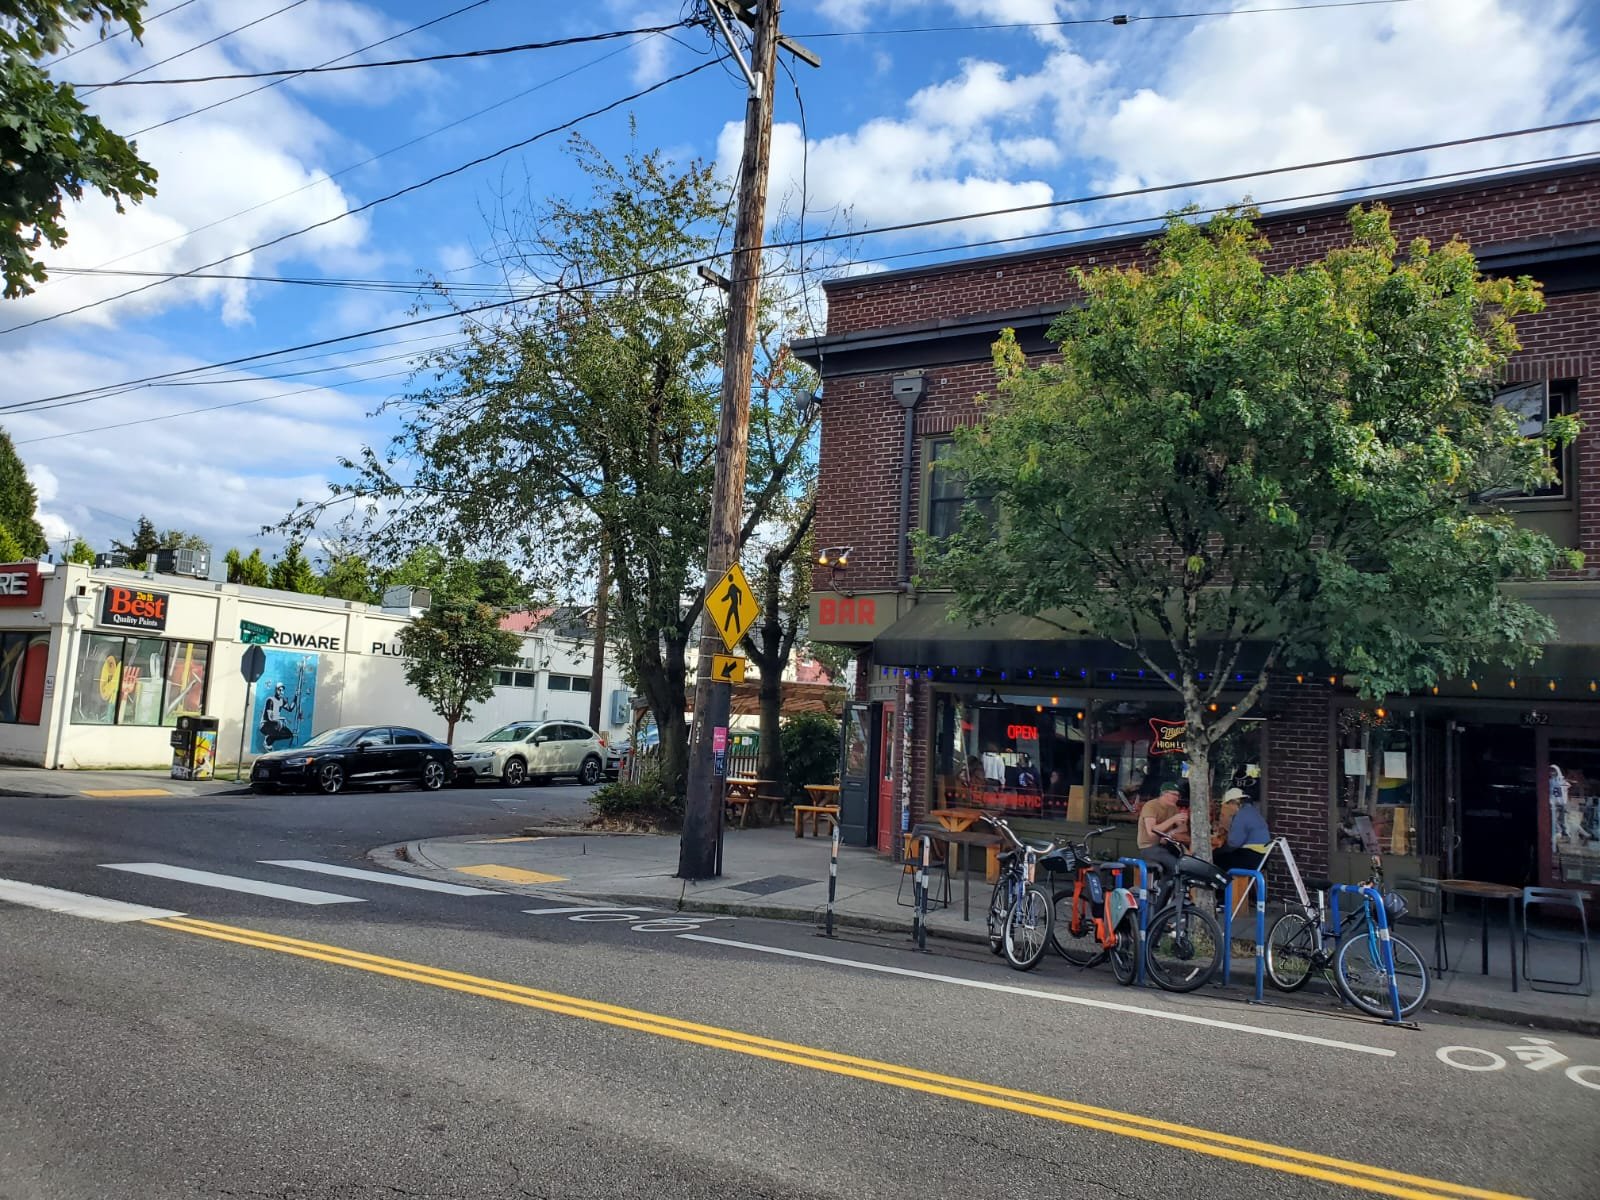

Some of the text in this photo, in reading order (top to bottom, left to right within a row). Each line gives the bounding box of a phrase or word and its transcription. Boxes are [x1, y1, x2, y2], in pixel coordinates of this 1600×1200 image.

[110, 587, 165, 619] Best
[818, 598, 876, 625] BAR
[113, 614, 158, 627] Quality Paints
[268, 631, 341, 651] RDWARE
[1007, 724, 1039, 740] OPEN
[1156, 740, 1175, 749] HIGH
